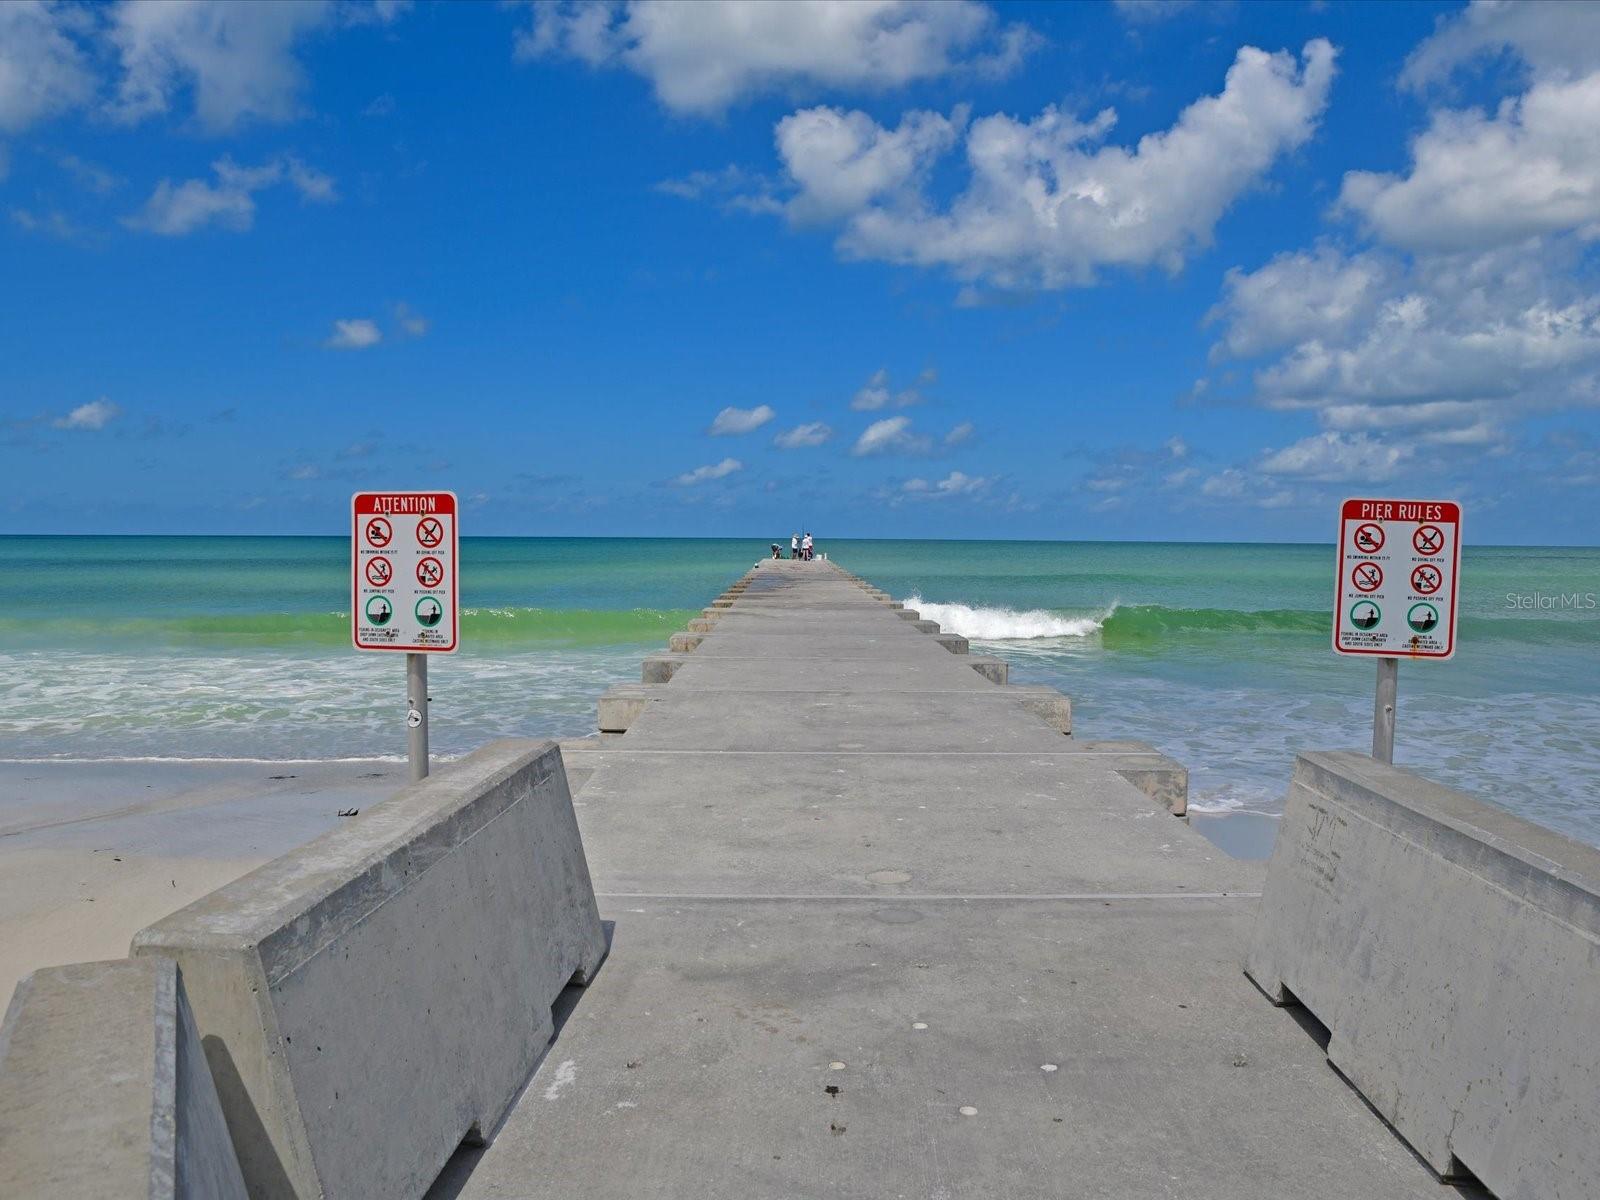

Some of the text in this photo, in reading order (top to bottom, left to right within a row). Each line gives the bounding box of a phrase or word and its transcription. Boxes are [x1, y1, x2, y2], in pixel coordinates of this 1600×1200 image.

[374, 497, 435, 512] ATTENTION
[1362, 503, 1442, 520] PIER RULES
